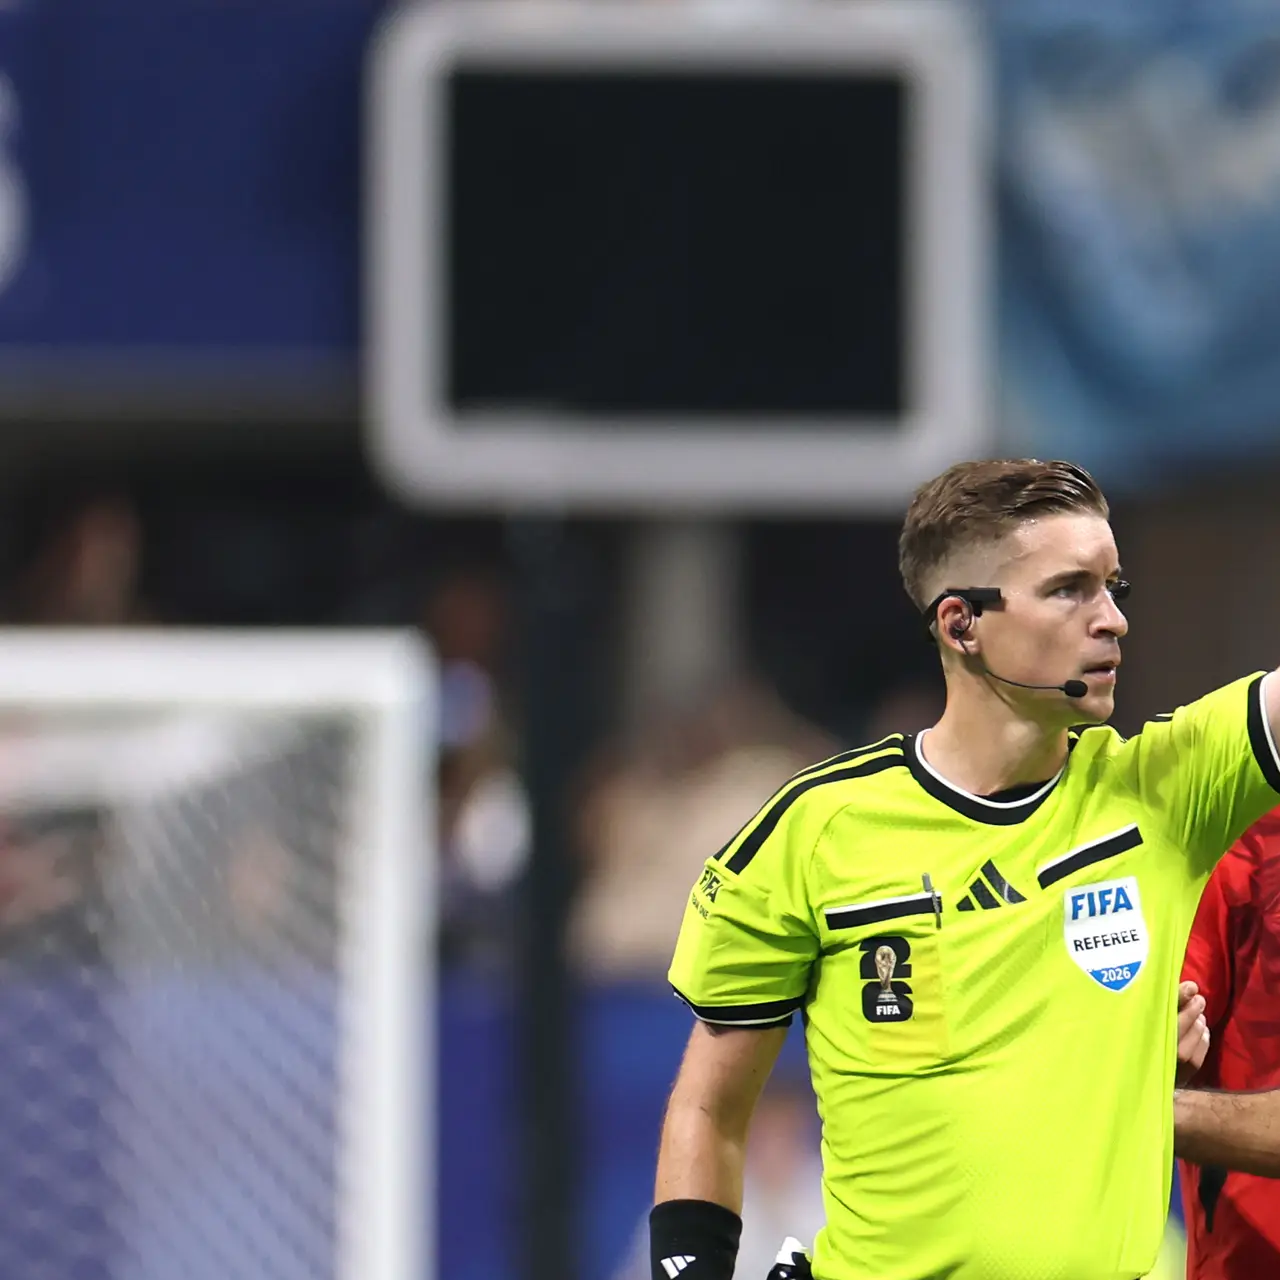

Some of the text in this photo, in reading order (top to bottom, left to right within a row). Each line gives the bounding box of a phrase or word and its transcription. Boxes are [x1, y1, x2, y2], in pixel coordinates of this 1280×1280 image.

[699, 869, 723, 904] FIFA
[1071, 886, 1133, 921] FIFA
[1073, 929, 1140, 952] REFEREE
[1100, 967, 1131, 983] 2026
[875, 1005, 901, 1016] FIFA
